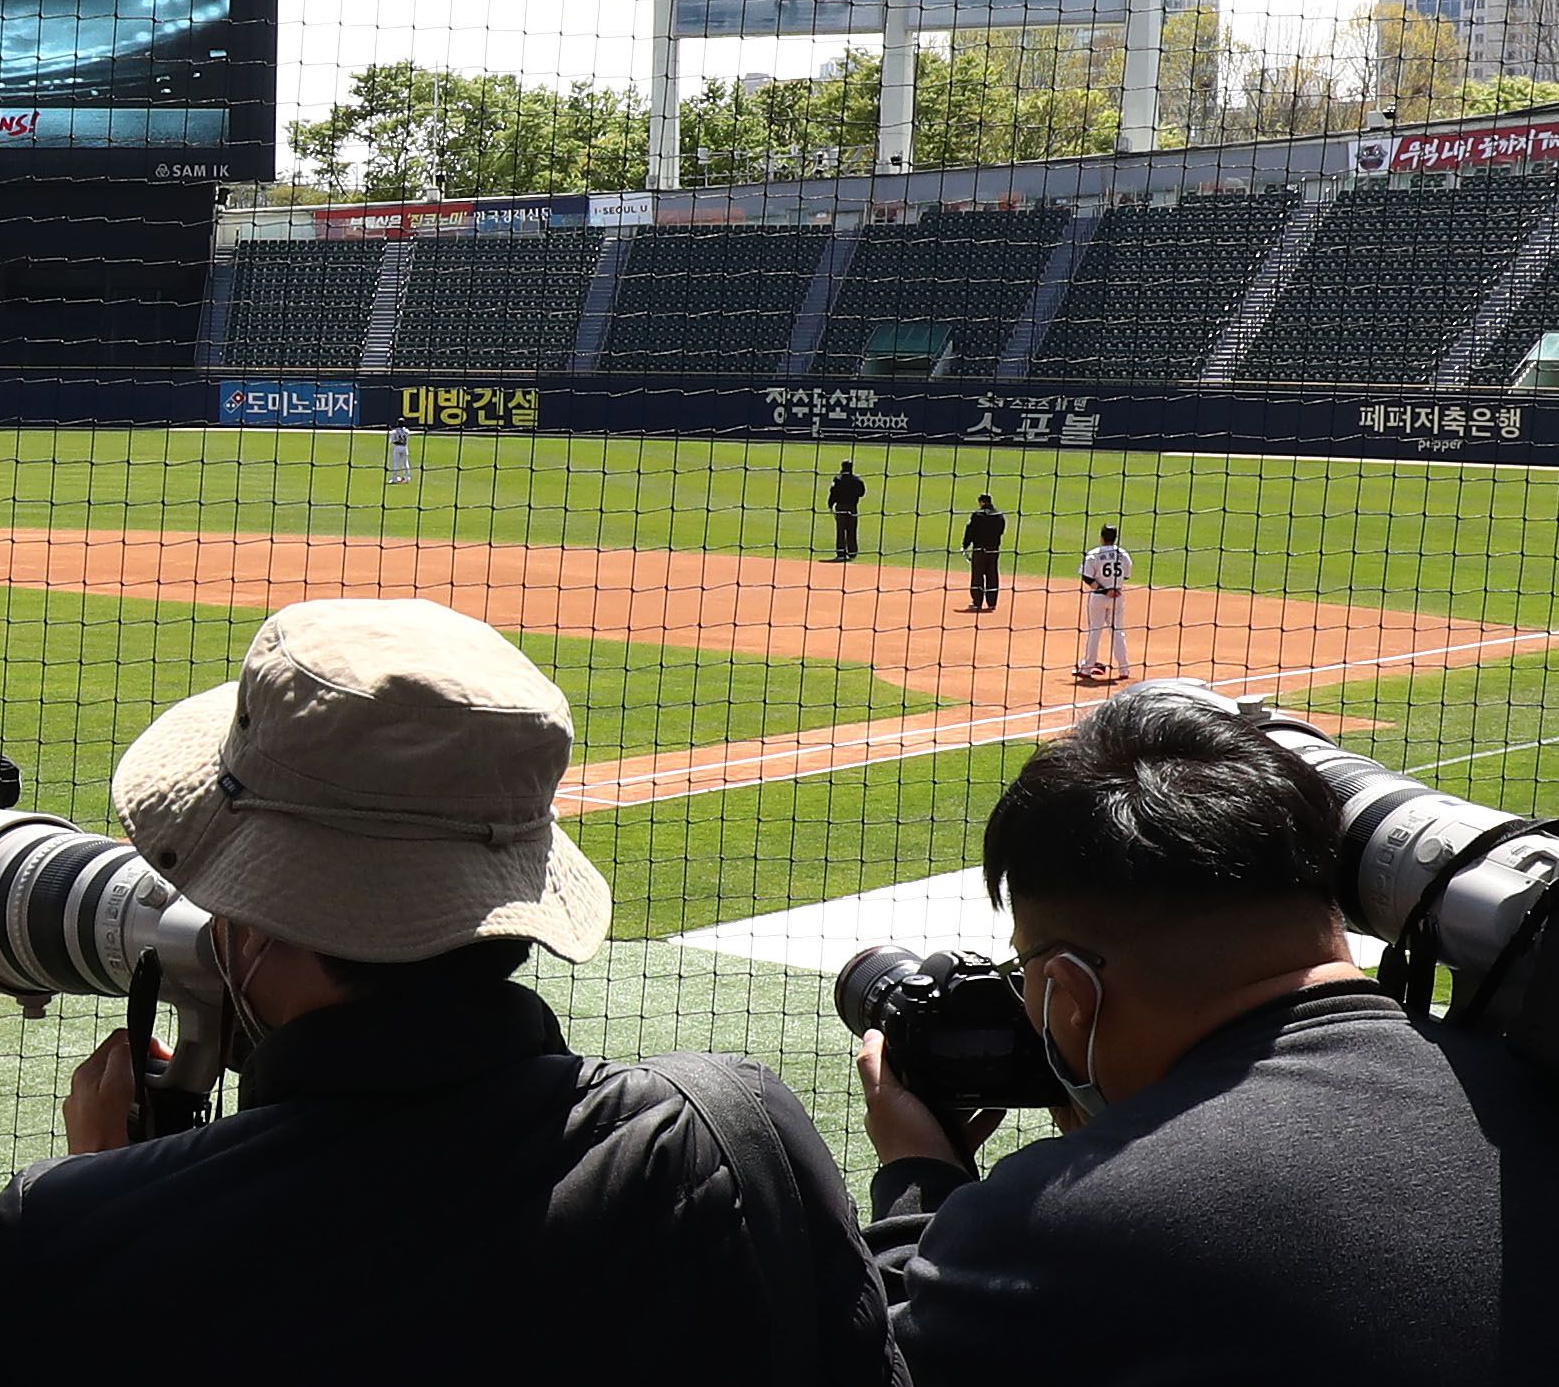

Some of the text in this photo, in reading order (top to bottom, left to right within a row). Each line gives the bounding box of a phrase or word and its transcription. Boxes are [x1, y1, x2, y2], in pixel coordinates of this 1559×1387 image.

[245, 388, 358, 418] 도미노피자
[401, 385, 540, 427] 대방건설
[1358, 405, 1521, 438] 페퍼저축은행
[1417, 438, 1464, 453] pepper
[1102, 562, 1123, 578] 65
